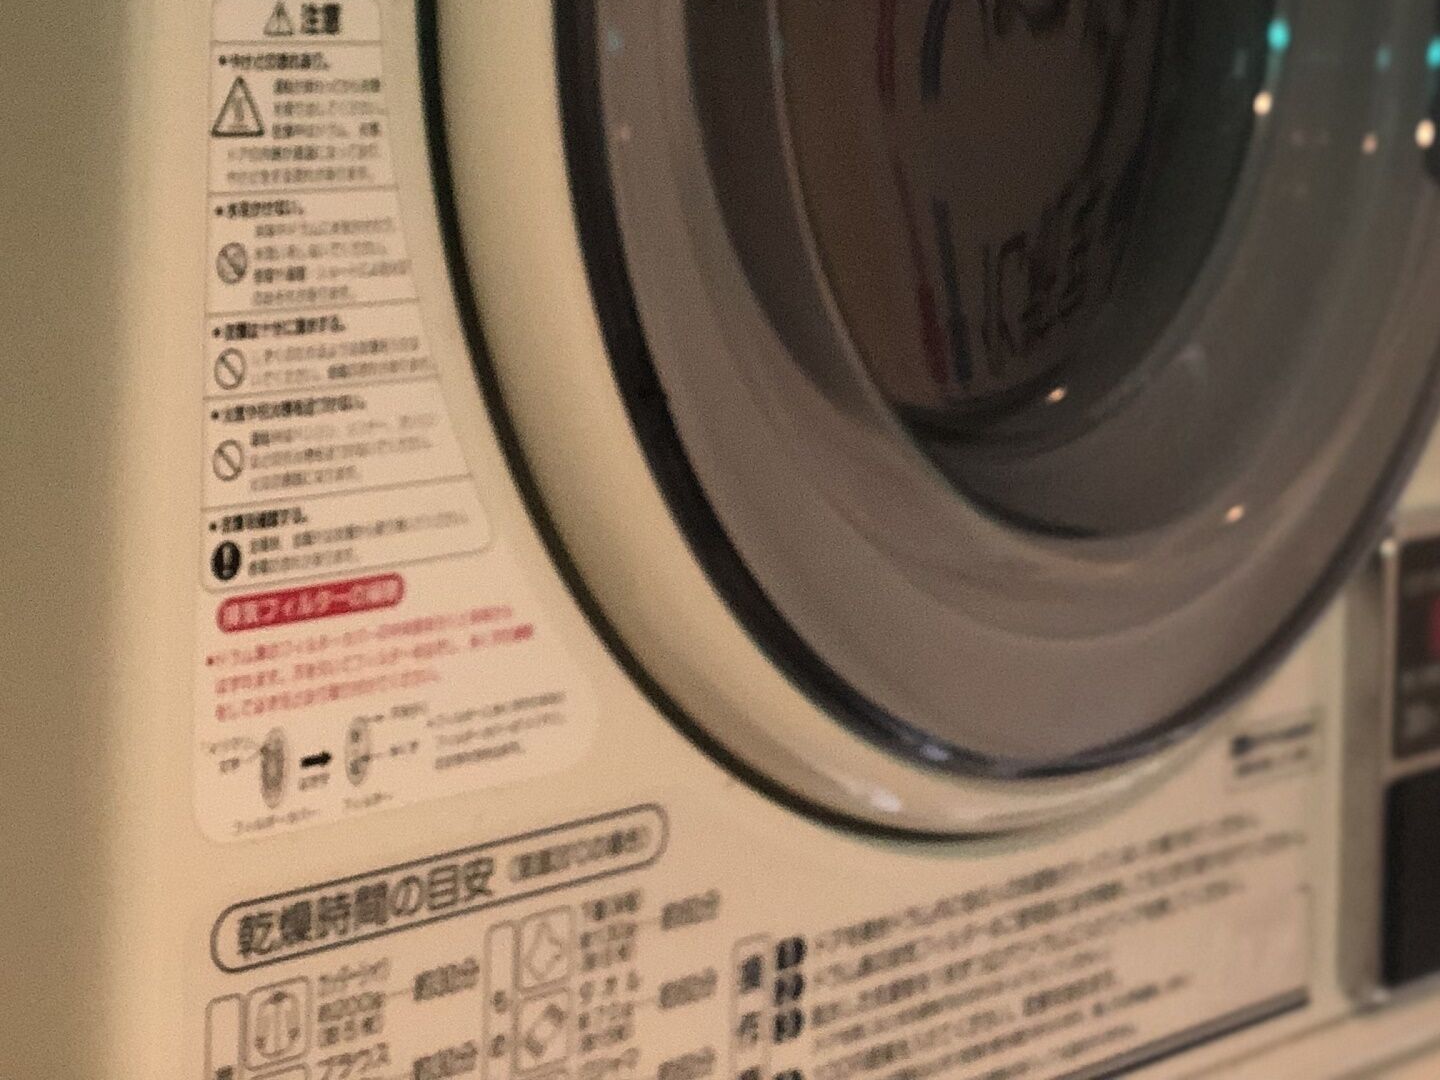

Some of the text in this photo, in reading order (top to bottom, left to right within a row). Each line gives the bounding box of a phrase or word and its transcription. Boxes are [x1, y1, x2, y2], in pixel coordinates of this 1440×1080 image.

[301, 3, 341, 34] 注意
[235, 856, 497, 960] 乾燥時間の目安
